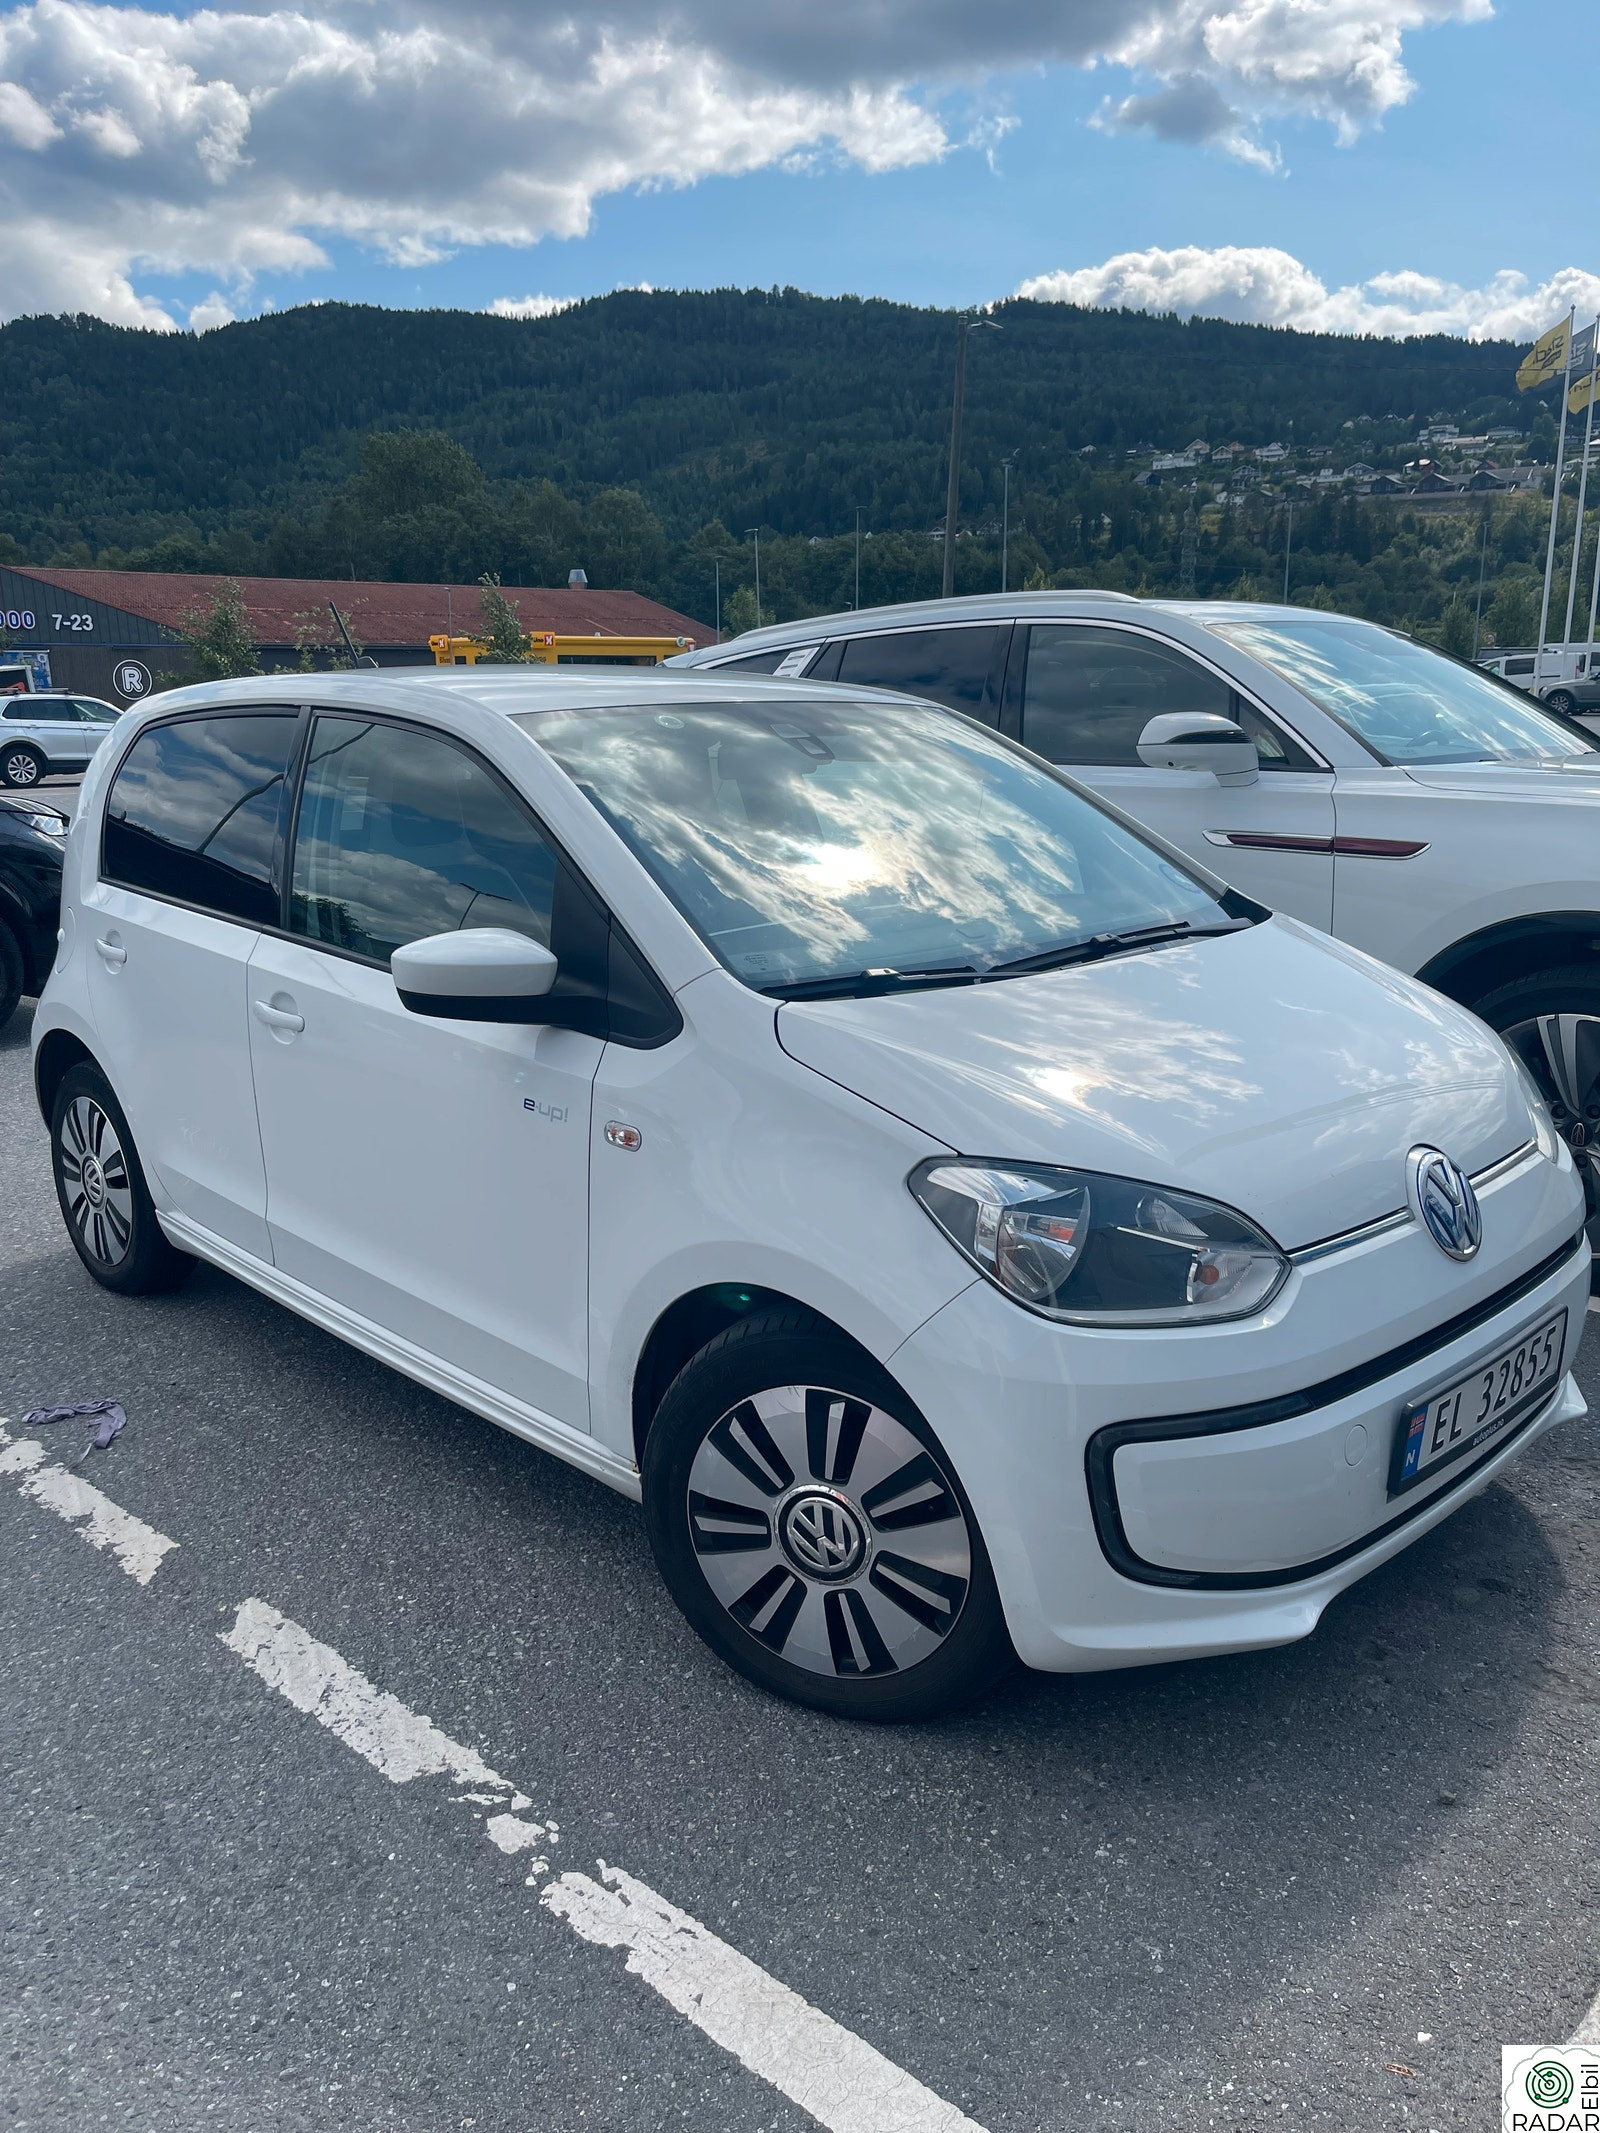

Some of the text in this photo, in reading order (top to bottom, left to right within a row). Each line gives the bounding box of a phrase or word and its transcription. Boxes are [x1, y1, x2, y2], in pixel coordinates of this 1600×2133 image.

[52, 614, 93, 631] 7-23
[121, 667, 143, 692] R
[1431, 1324, 1557, 1454] EL 32855
[1405, 1449, 1415, 1467] N
